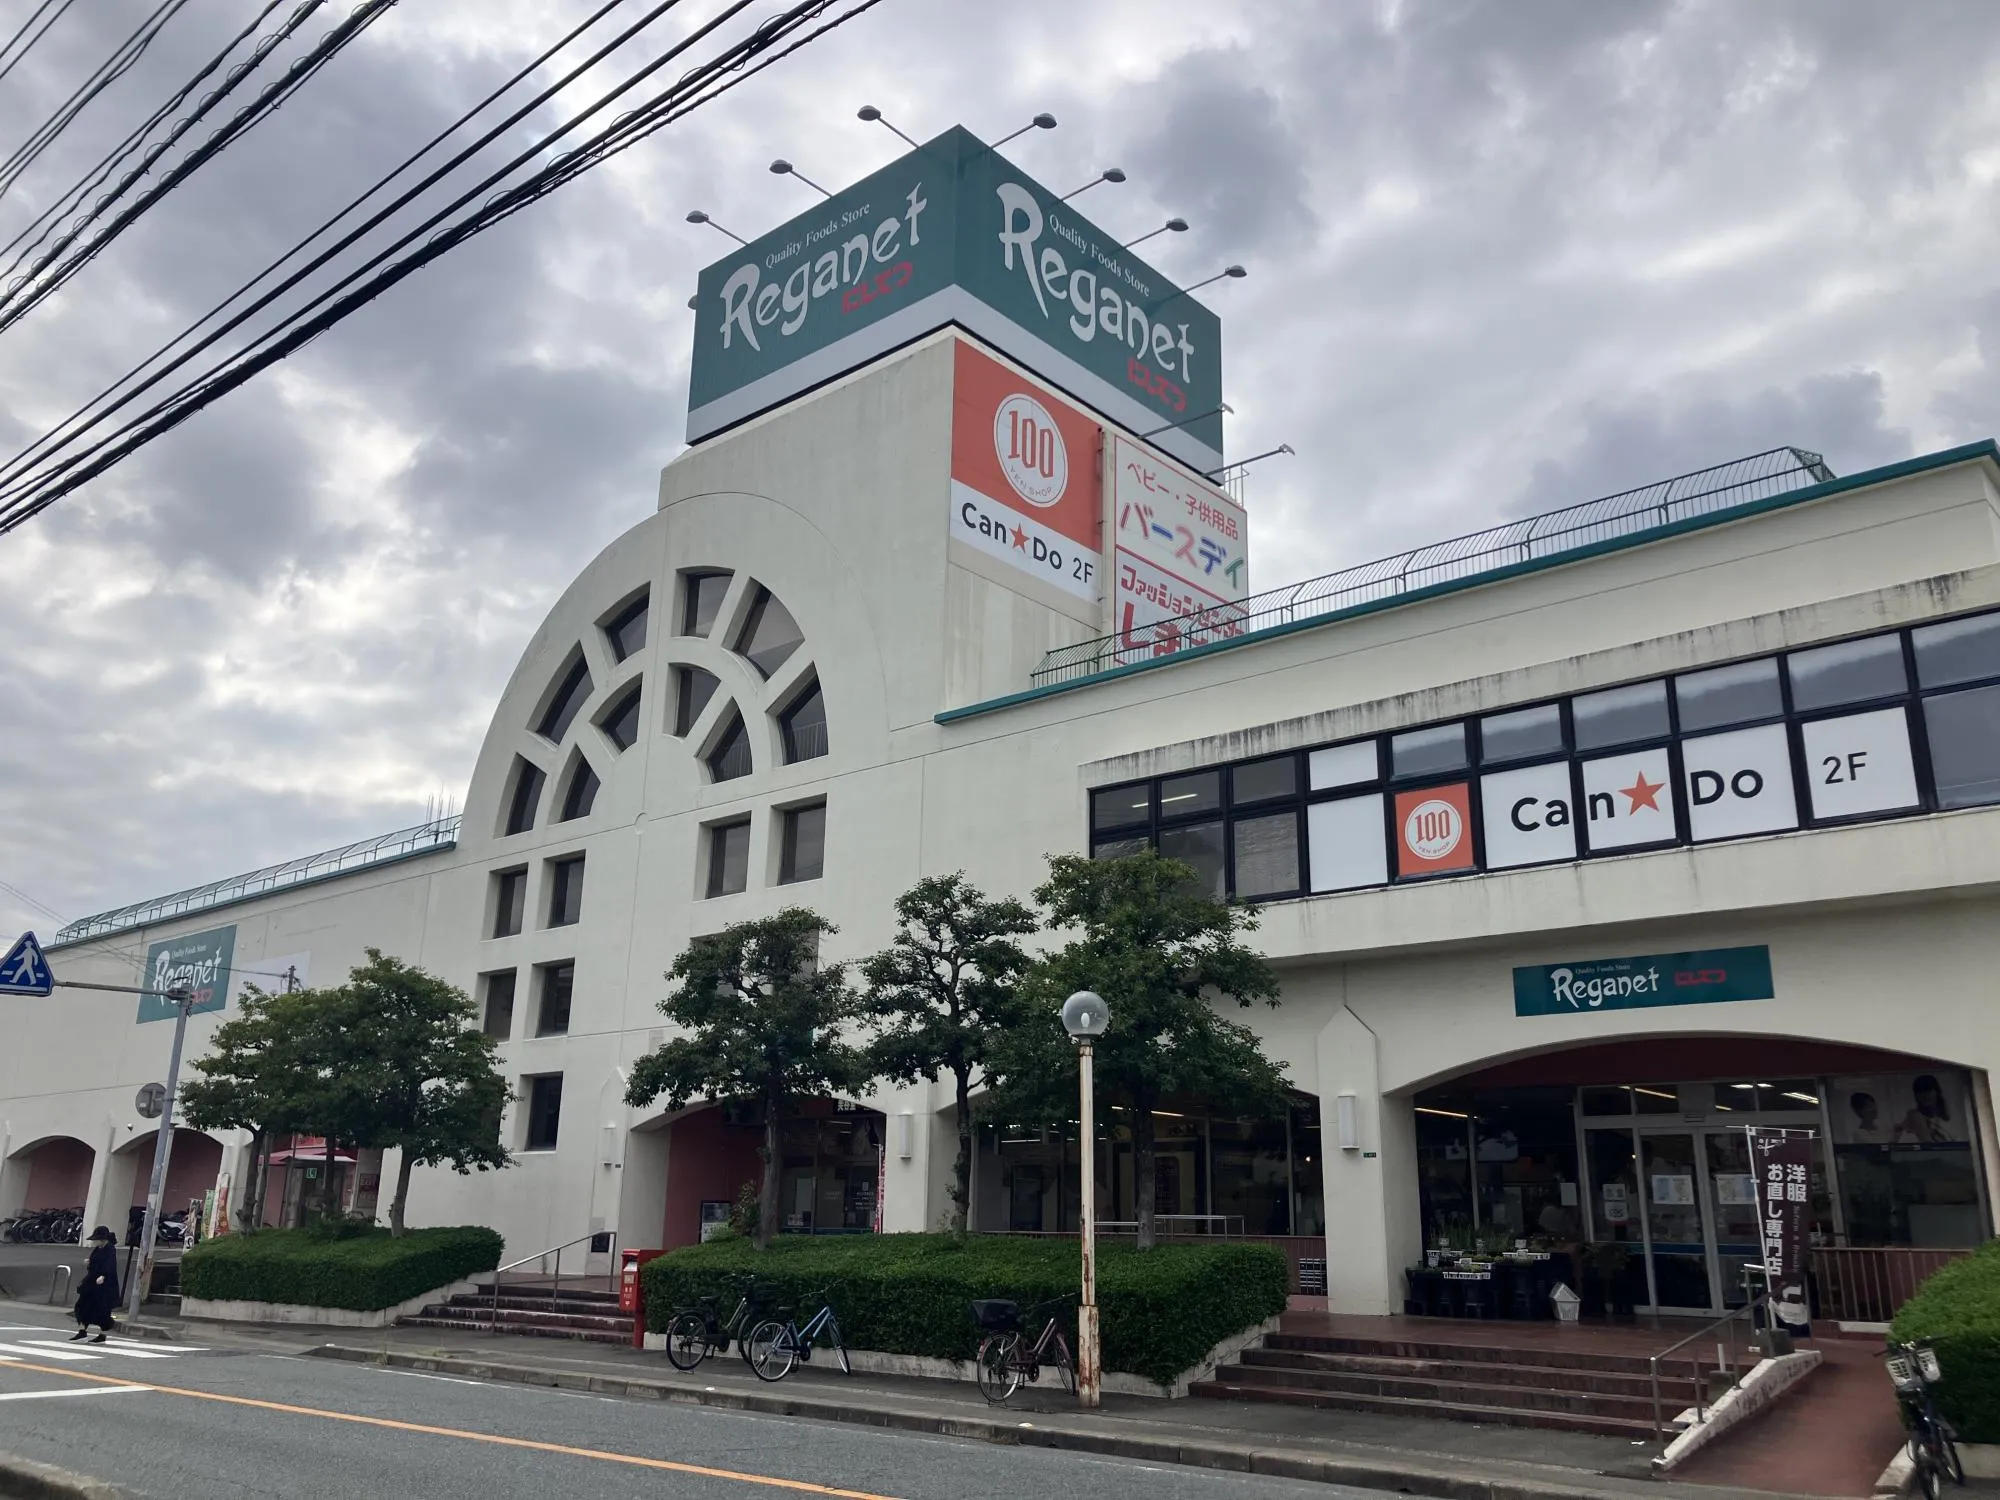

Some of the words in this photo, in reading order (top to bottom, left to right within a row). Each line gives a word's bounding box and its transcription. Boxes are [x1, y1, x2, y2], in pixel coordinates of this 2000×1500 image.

[719, 181, 928, 352] Reganet
[765, 240, 802, 269] Quality
[806, 220, 838, 247] Foods
[841, 203, 871, 228] Store
[1049, 213, 1087, 254] Quality
[1091, 243, 1122, 278] Foods
[1124, 268, 1150, 297] Store
[996, 182, 1195, 384] Reganet
[1007, 410, 1054, 479] 100
[961, 502, 1007, 545] Can
[1033, 536, 1062, 570] Do
[1072, 557, 1093, 583] 2F
[1415, 809, 1450, 844] 100
[1510, 790, 1615, 832] Can
[1689, 768, 1764, 806] Do
[1822, 751, 1867, 784] 2F
[1550, 965, 1660, 1009] Reganet
[1765, 1163, 1784, 1276] お直し専門店
[1786, 1163, 1807, 1203] 洋服
